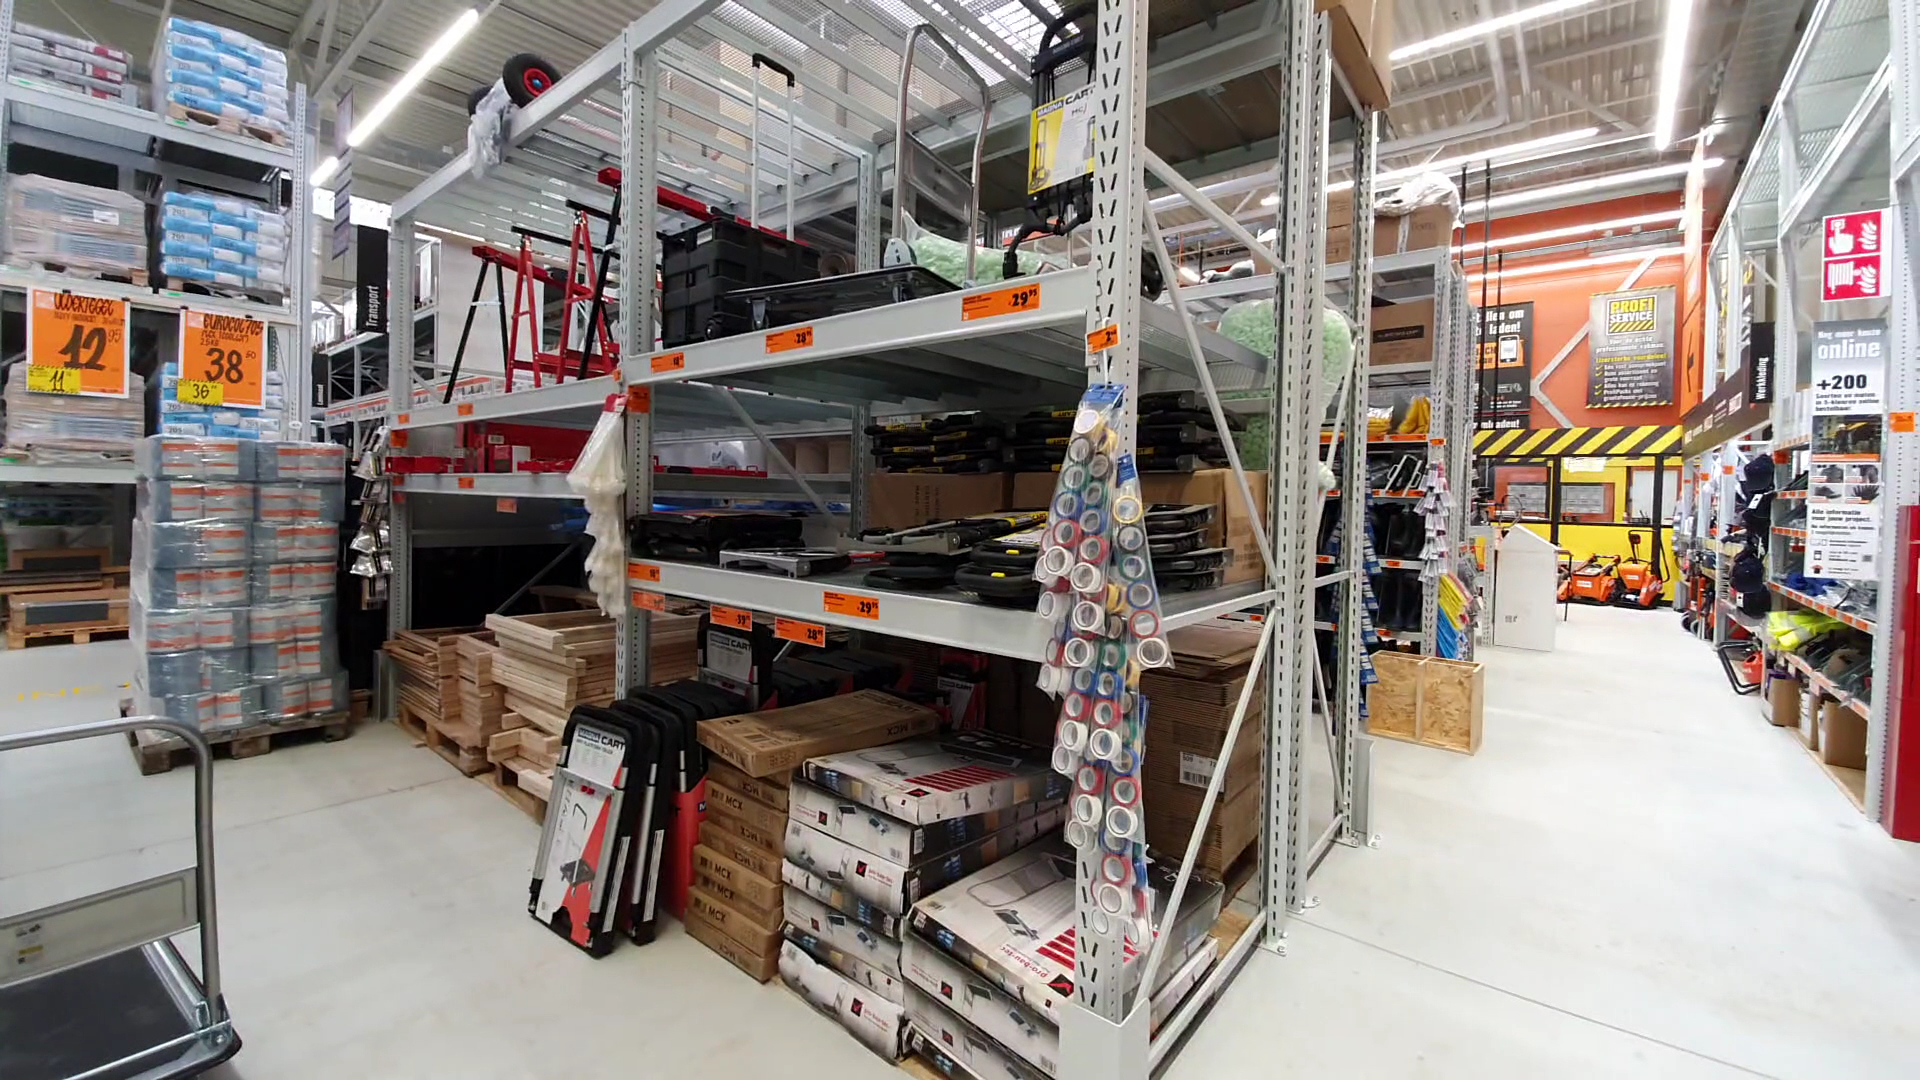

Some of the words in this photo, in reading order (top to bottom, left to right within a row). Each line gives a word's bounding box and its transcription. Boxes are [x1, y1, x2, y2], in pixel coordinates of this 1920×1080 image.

[366, 285, 380, 326] Transport
[1012, 291, 1028, 307] 29
[1611, 297, 1653, 315] PROFI
[1509, 309, 1524, 320] om
[1610, 311, 1653, 324] SERVICE
[108, 329, 121, 342] 95
[796, 332, 806, 345] 28
[59, 324, 107, 371] 12
[1817, 338, 1880, 360] online
[205, 348, 243, 384] 38
[49, 370, 65, 392] 11
[1816, 374, 1868, 391] +200
[860, 601, 872, 614] 29
[807, 628, 818, 641] 28
[601, 735, 626, 751] CART
[725, 794, 743, 811] MCX
[740, 825, 758, 842] MCX
[714, 863, 732, 880] MCX
[716, 883, 735, 900] MCX
[708, 905, 726, 923] MCX
[999, 946, 1049, 979] pro-bau-tec
